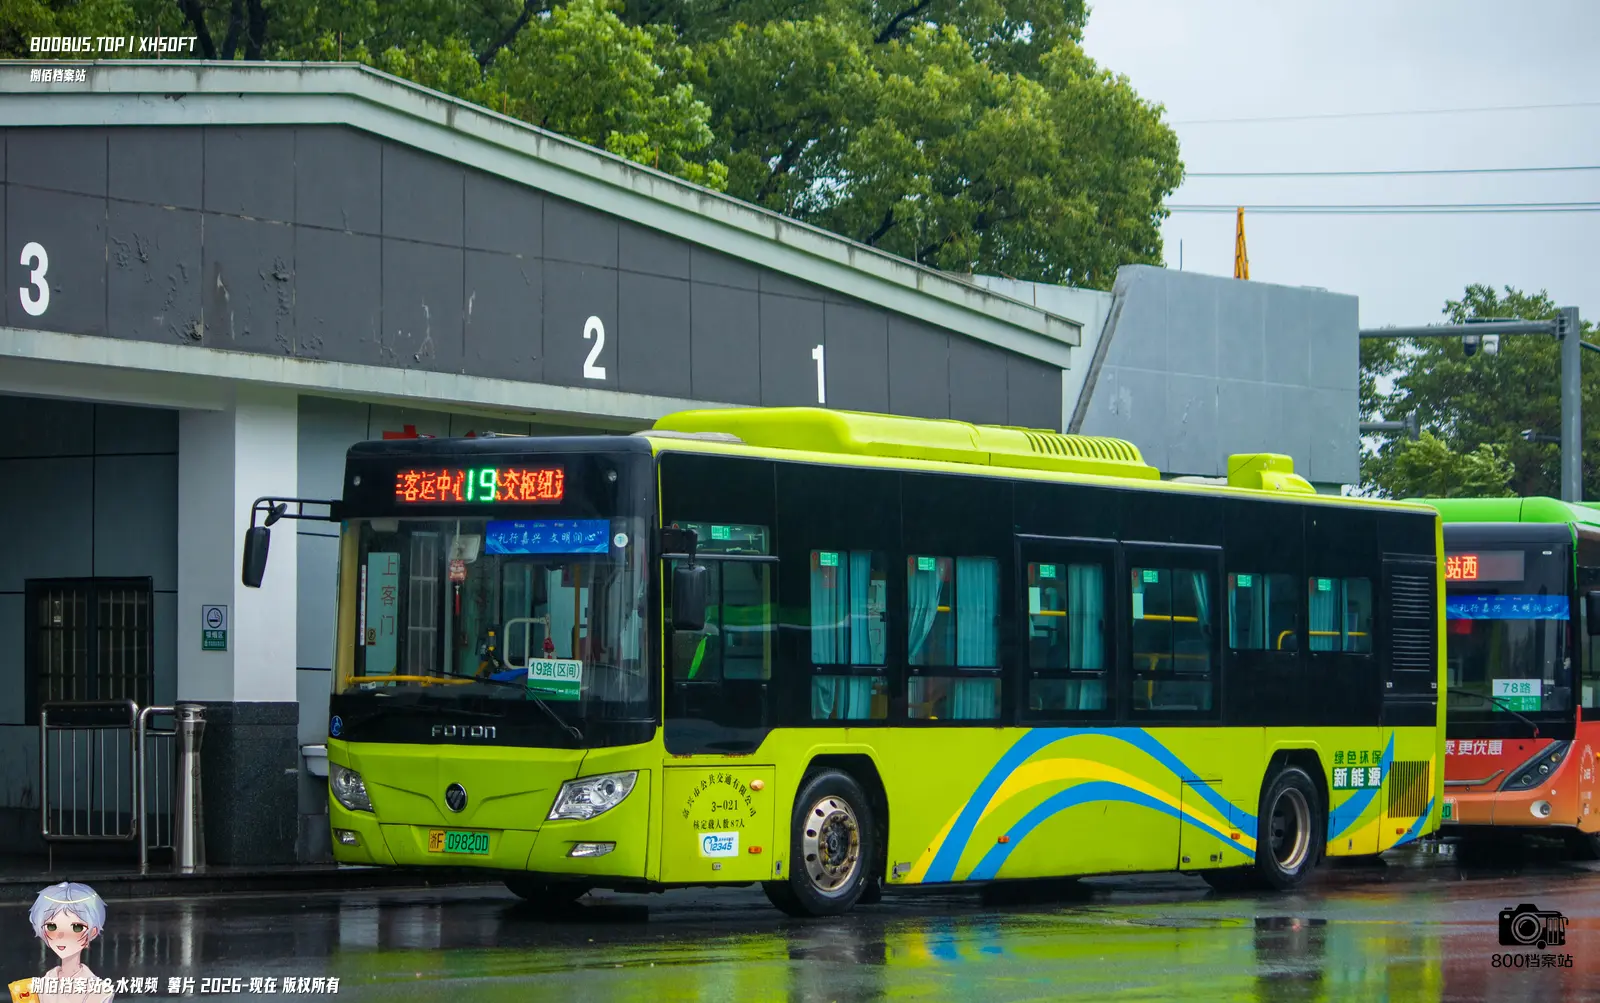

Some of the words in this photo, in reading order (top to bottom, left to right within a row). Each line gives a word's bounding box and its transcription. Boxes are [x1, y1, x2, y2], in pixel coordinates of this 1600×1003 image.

[19, 241, 50, 317] 3
[583, 315, 607, 380] 2
[811, 344, 826, 404] 1
[465, 468, 497, 501] 19
[1443, 556, 1478, 579] 站西
[380, 555, 397, 637] 上客门
[530, 661, 580, 679] 19路(区间)
[1502, 682, 1531, 694] 78路
[431, 725, 496, 739] FOTON
[1334, 750, 1382, 765] 绿色环保
[1457, 740, 1503, 756] 更优惠
[1333, 767, 1381, 787] 新能源
[711, 799, 739, 813] 3-021
